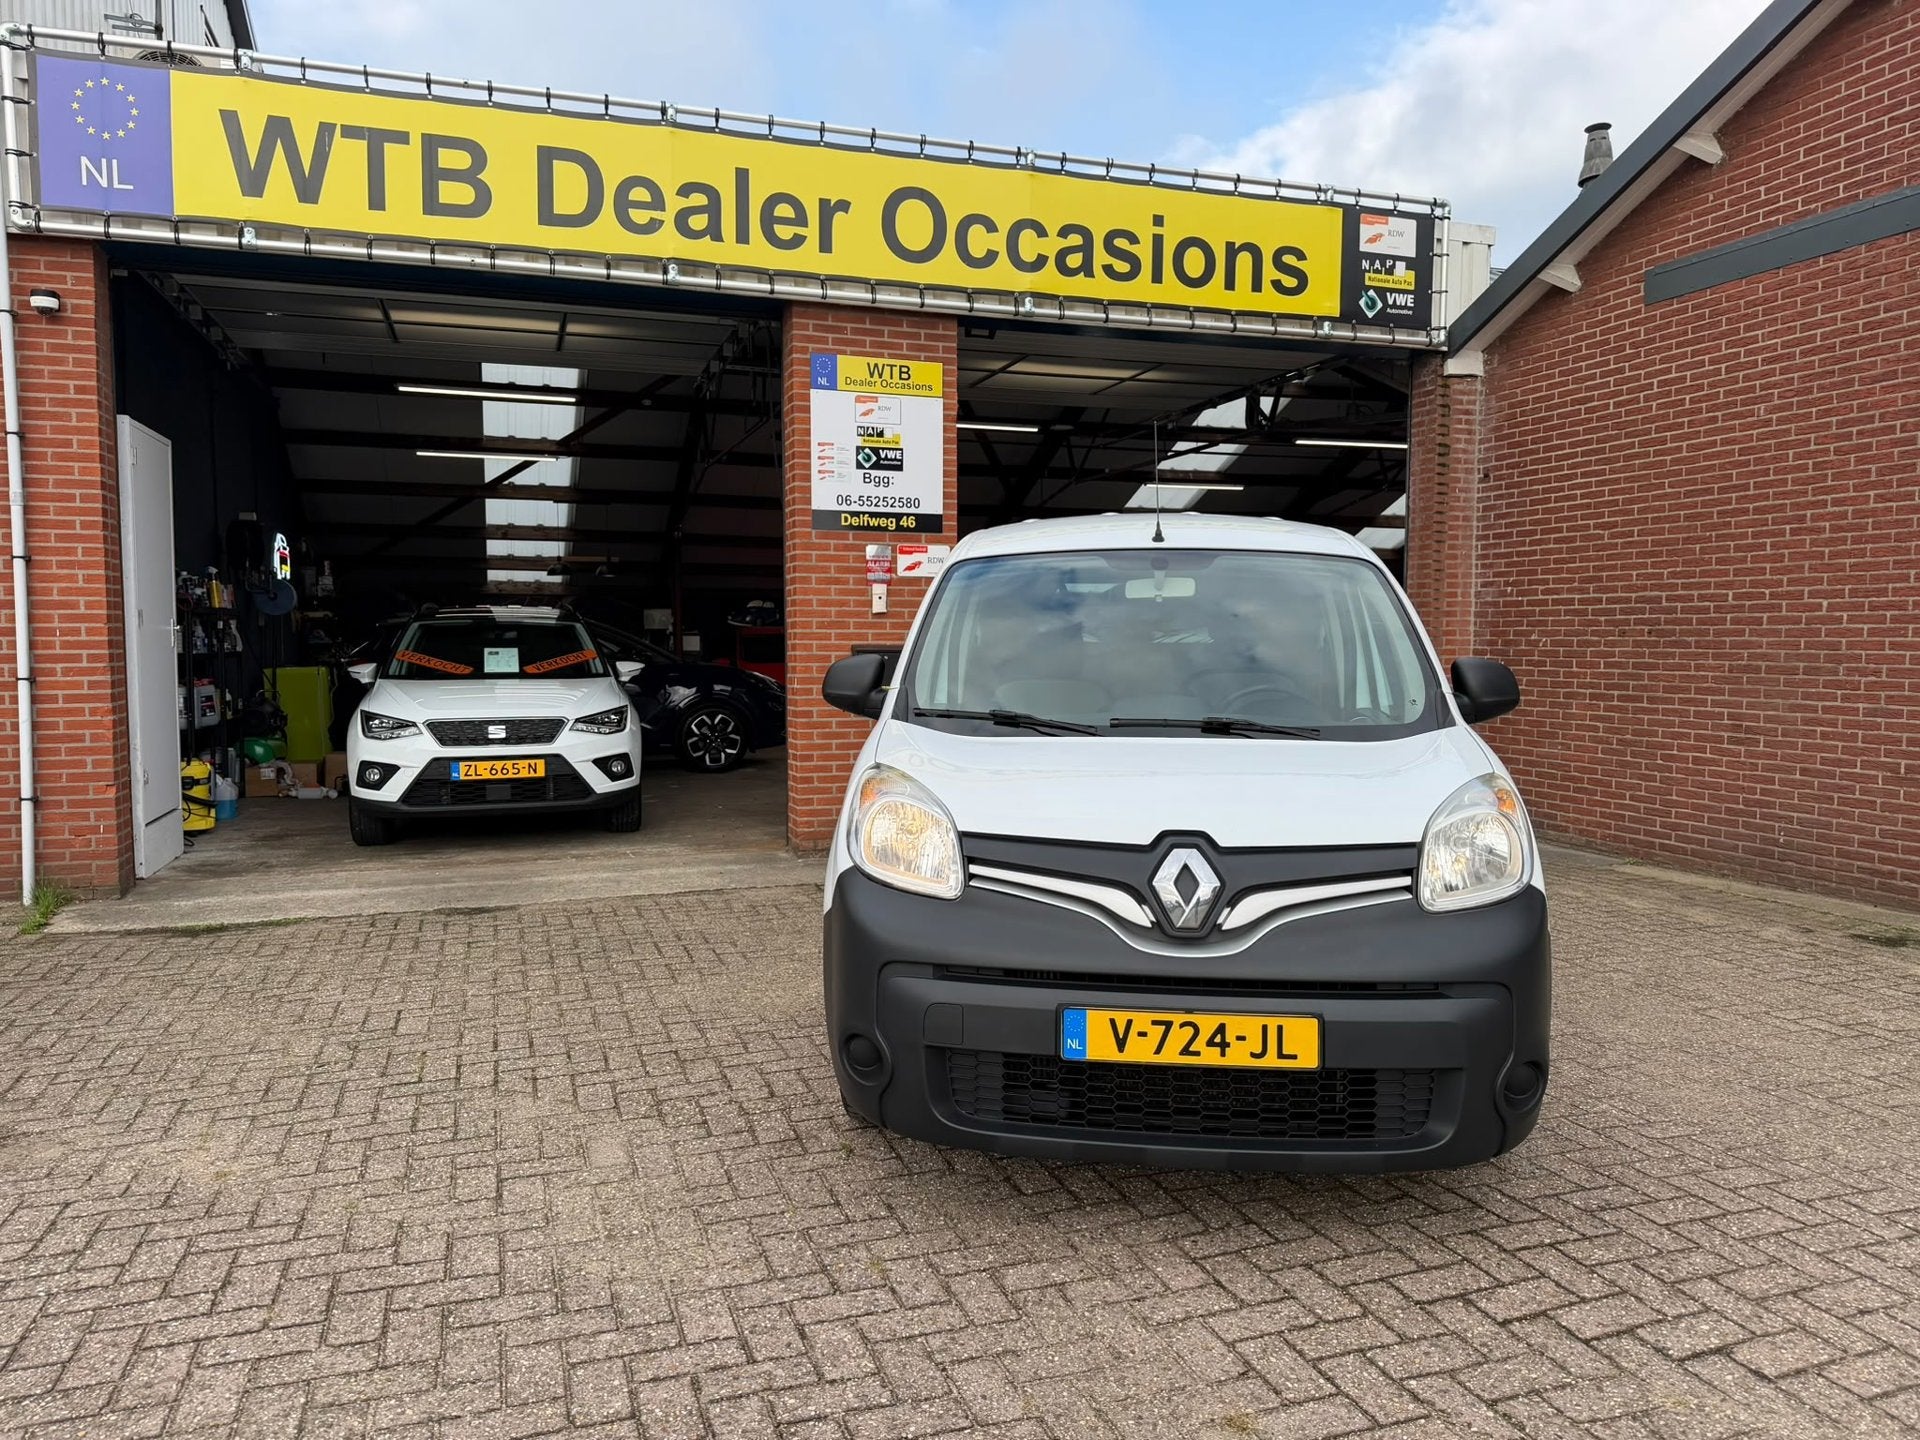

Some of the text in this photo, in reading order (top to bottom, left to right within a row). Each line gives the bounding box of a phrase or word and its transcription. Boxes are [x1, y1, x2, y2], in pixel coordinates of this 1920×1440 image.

[80, 156, 134, 191] NL
[219, 109, 1310, 298] WTB Dealer Occasions
[1387, 230, 1405, 238] RDW
[1368, 275, 1413, 287] Nationale Auto Pas
[1386, 292, 1415, 307] VWE
[867, 362, 911, 381] WTB
[817, 376, 830, 386] NL
[844, 376, 933, 392] Dealer Occasions
[879, 449, 903, 460] VWE
[863, 472, 895, 488] Bgg:
[836, 494, 921, 509] 06-55252580
[840, 513, 916, 530] Delfweg 46
[927, 556, 945, 564] RDW
[400, 650, 468, 673] VERKOCHT
[534, 650, 587, 672] VERKOCHT
[464, 762, 538, 777] ZL-665-N
[1067, 1038, 1083, 1050] NL
[1108, 1017, 1298, 1061] V-724-JL
